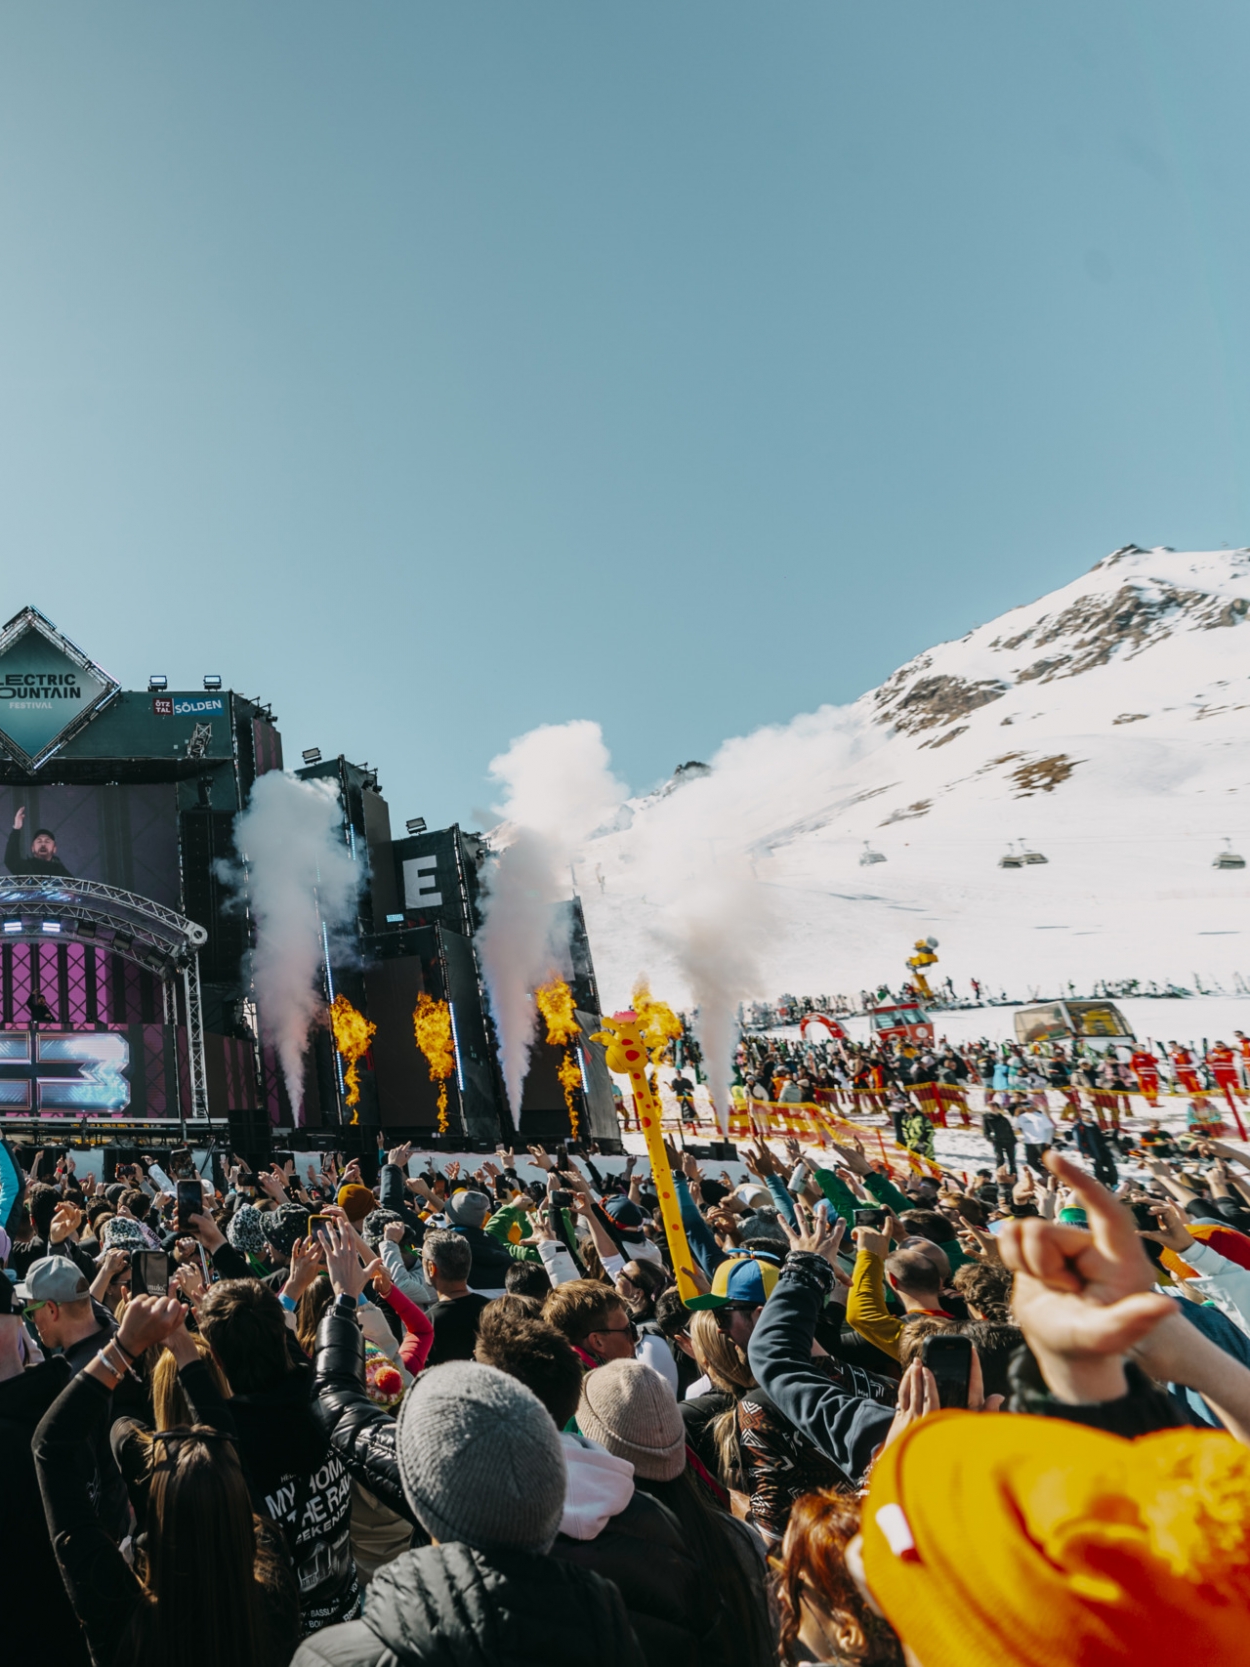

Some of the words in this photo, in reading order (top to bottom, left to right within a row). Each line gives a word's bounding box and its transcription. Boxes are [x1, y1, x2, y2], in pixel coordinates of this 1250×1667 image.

[9, 701, 53, 709] FESTIVAL
[175, 700, 223, 713] SÖLDEN
[402, 855, 443, 909] E
[265, 1482, 295, 1520] MY
[309, 1457, 345, 1494] OM
